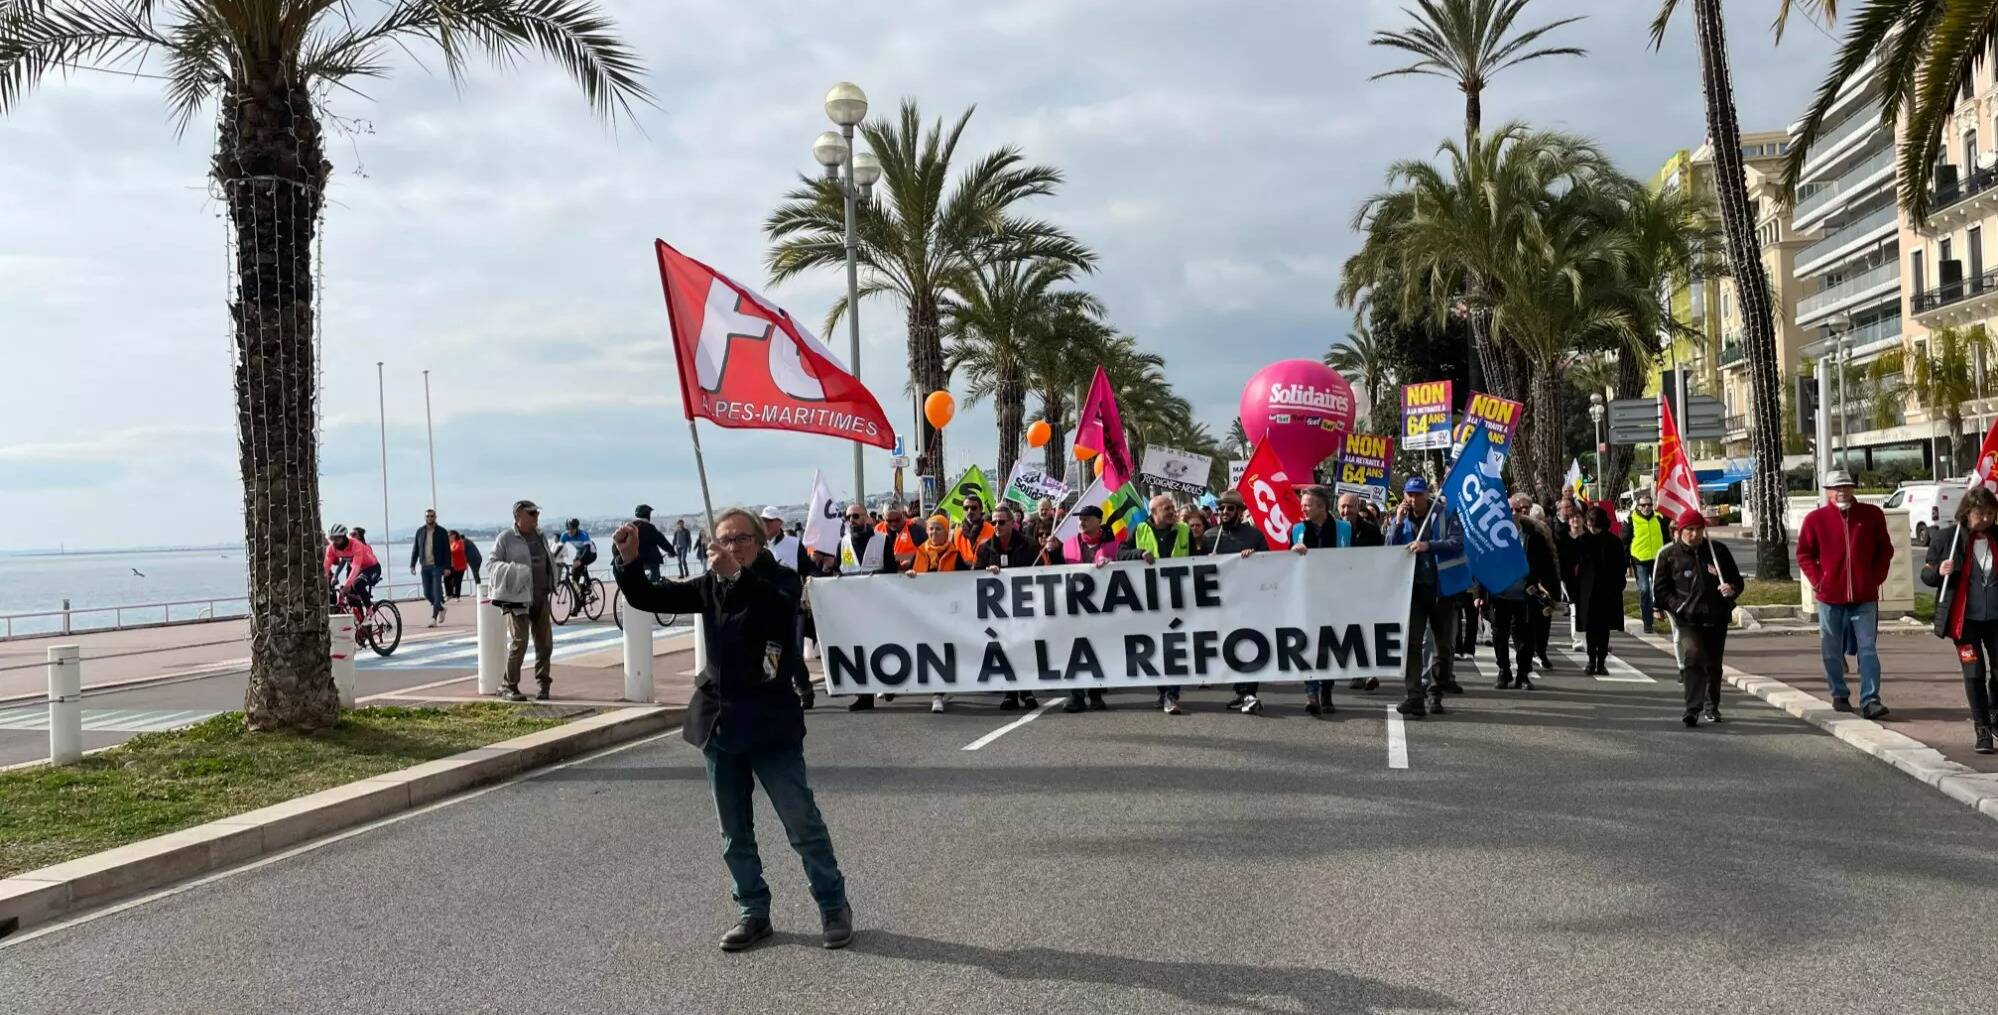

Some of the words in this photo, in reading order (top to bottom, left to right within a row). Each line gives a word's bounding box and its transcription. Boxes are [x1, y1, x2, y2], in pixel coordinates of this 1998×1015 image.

[1269, 383, 1348, 412] Solidaires
[1407, 383, 1445, 407] NON
[1470, 394, 1515, 425] NON
[1407, 414, 1429, 436] 64
[1428, 413, 1446, 424] ANS
[1345, 433, 1386, 459] NON
[1342, 463, 1367, 486] 64
[1366, 468, 1384, 479] ANS
[976, 564, 1220, 619] RETRAITE
[827, 643, 956, 685] NON
[977, 627, 1017, 682] À
[1034, 637, 1104, 680] LA
[1124, 617, 1402, 677] RÉFORME
